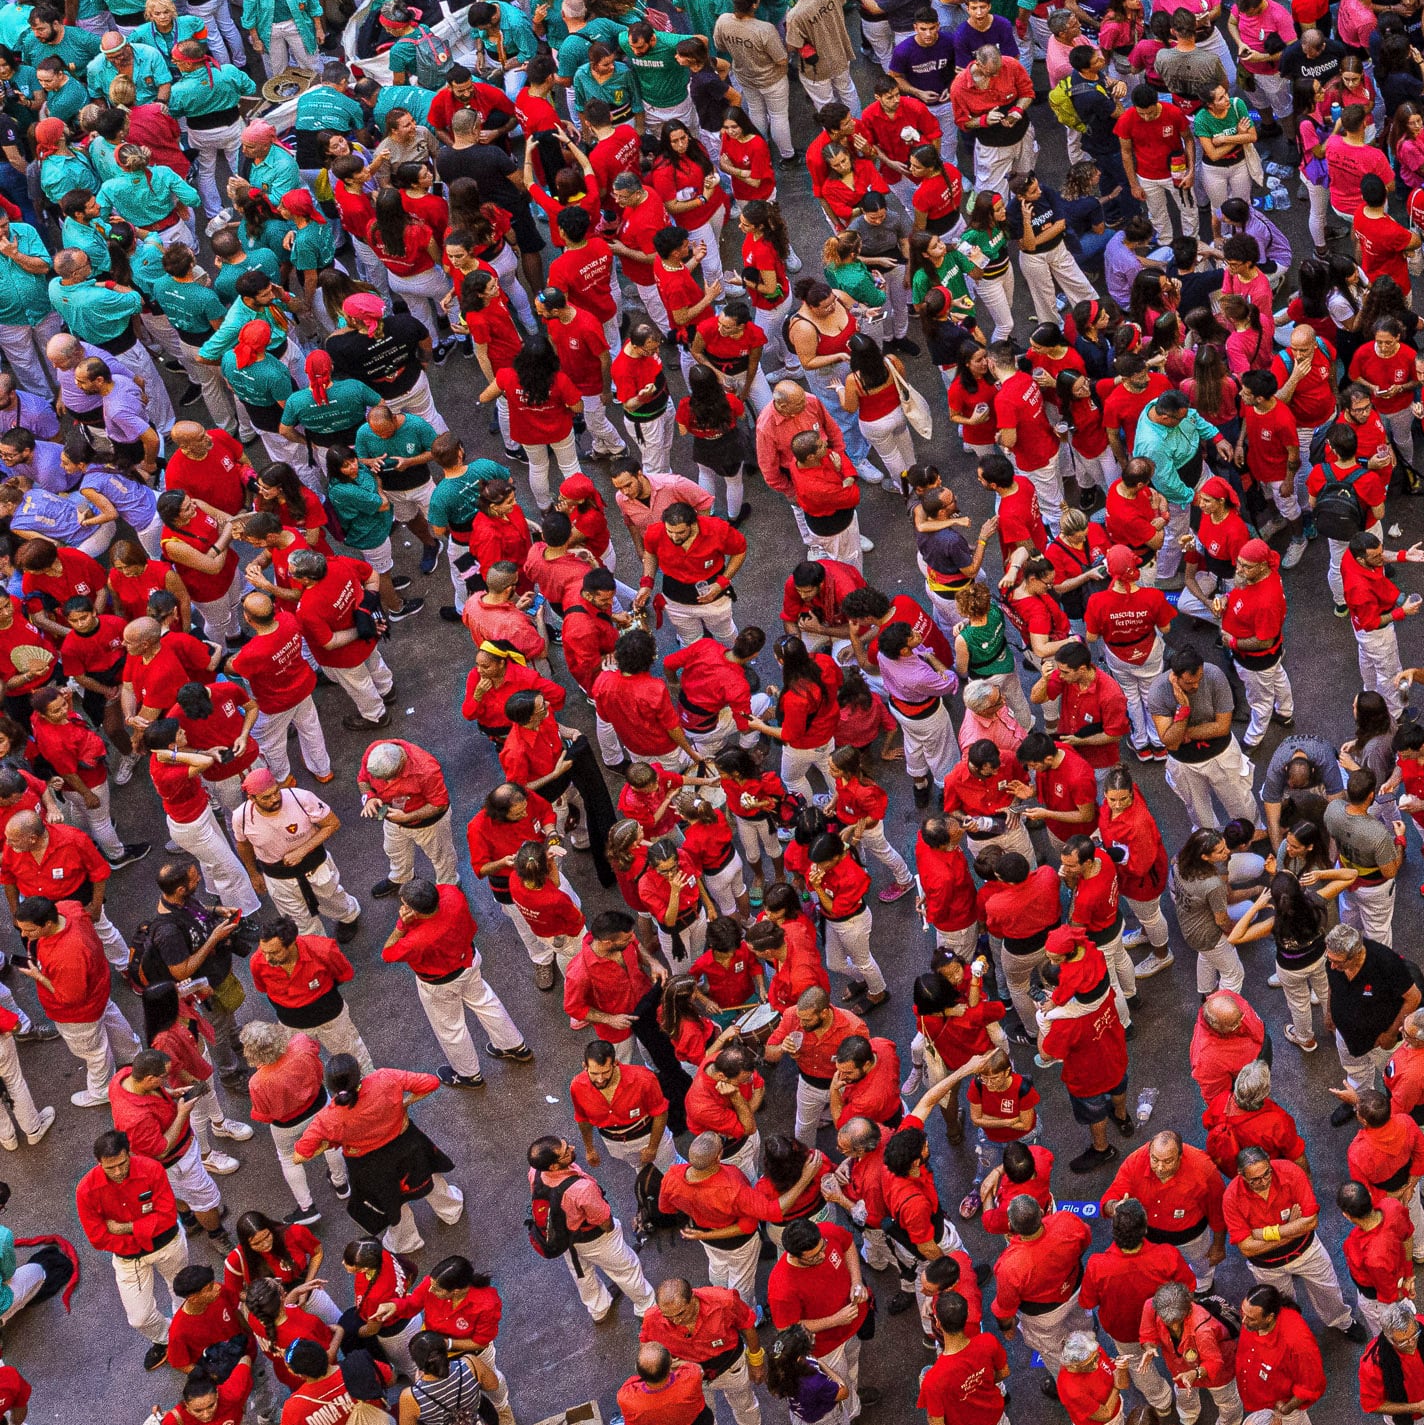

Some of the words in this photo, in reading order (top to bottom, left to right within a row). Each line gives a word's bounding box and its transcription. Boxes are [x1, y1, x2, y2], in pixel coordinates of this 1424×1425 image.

[1301, 60, 1339, 77] Capgrossos
[579, 259, 600, 275] nascuts
[599, 255, 609, 266] per
[1110, 612, 1134, 620] nascuts
[1136, 610, 1148, 618] per
[271, 640, 293, 662] nascuts
[1062, 1204, 1079, 1213] Fila
